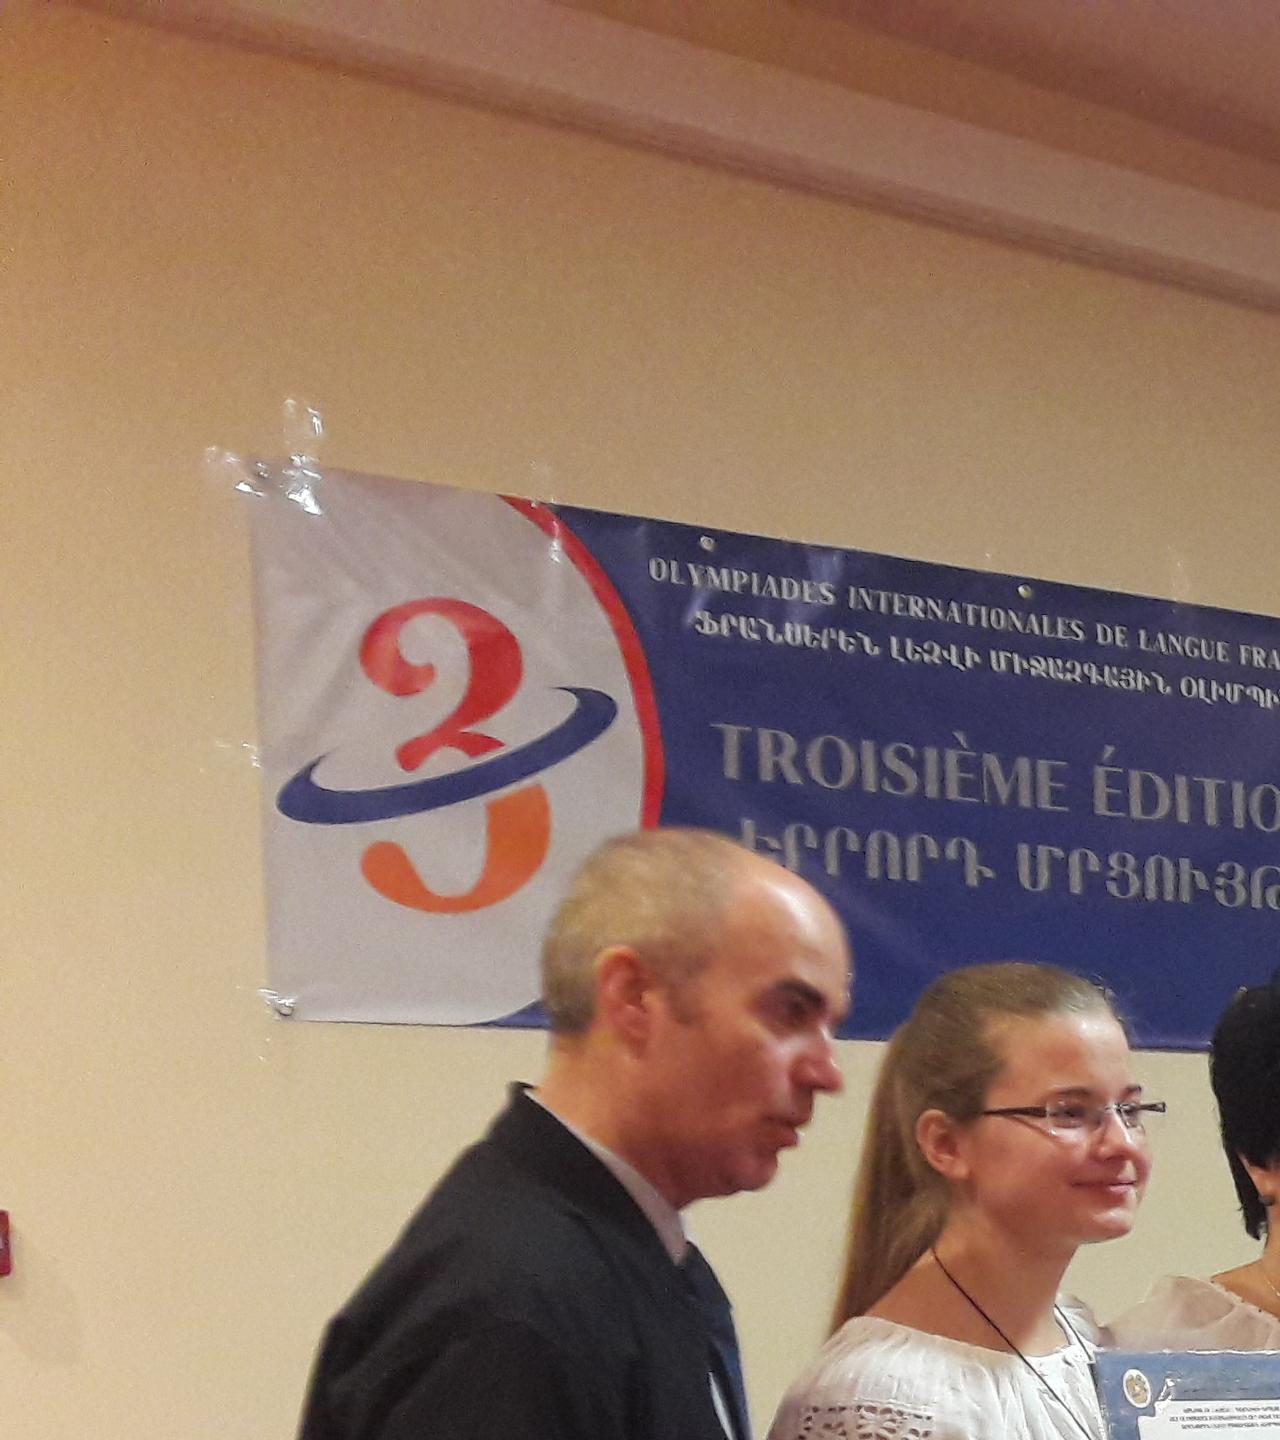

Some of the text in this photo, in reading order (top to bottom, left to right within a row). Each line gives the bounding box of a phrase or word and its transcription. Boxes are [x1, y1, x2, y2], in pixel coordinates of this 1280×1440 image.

[648, 556, 837, 606] OLYMPIADES
[848, 584, 1085, 642] INTERNATIONALES
[1095, 622, 1129, 649] DE
[1138, 628, 1231, 663] LANGUE
[708, 722, 1069, 811] TROISIÈME
